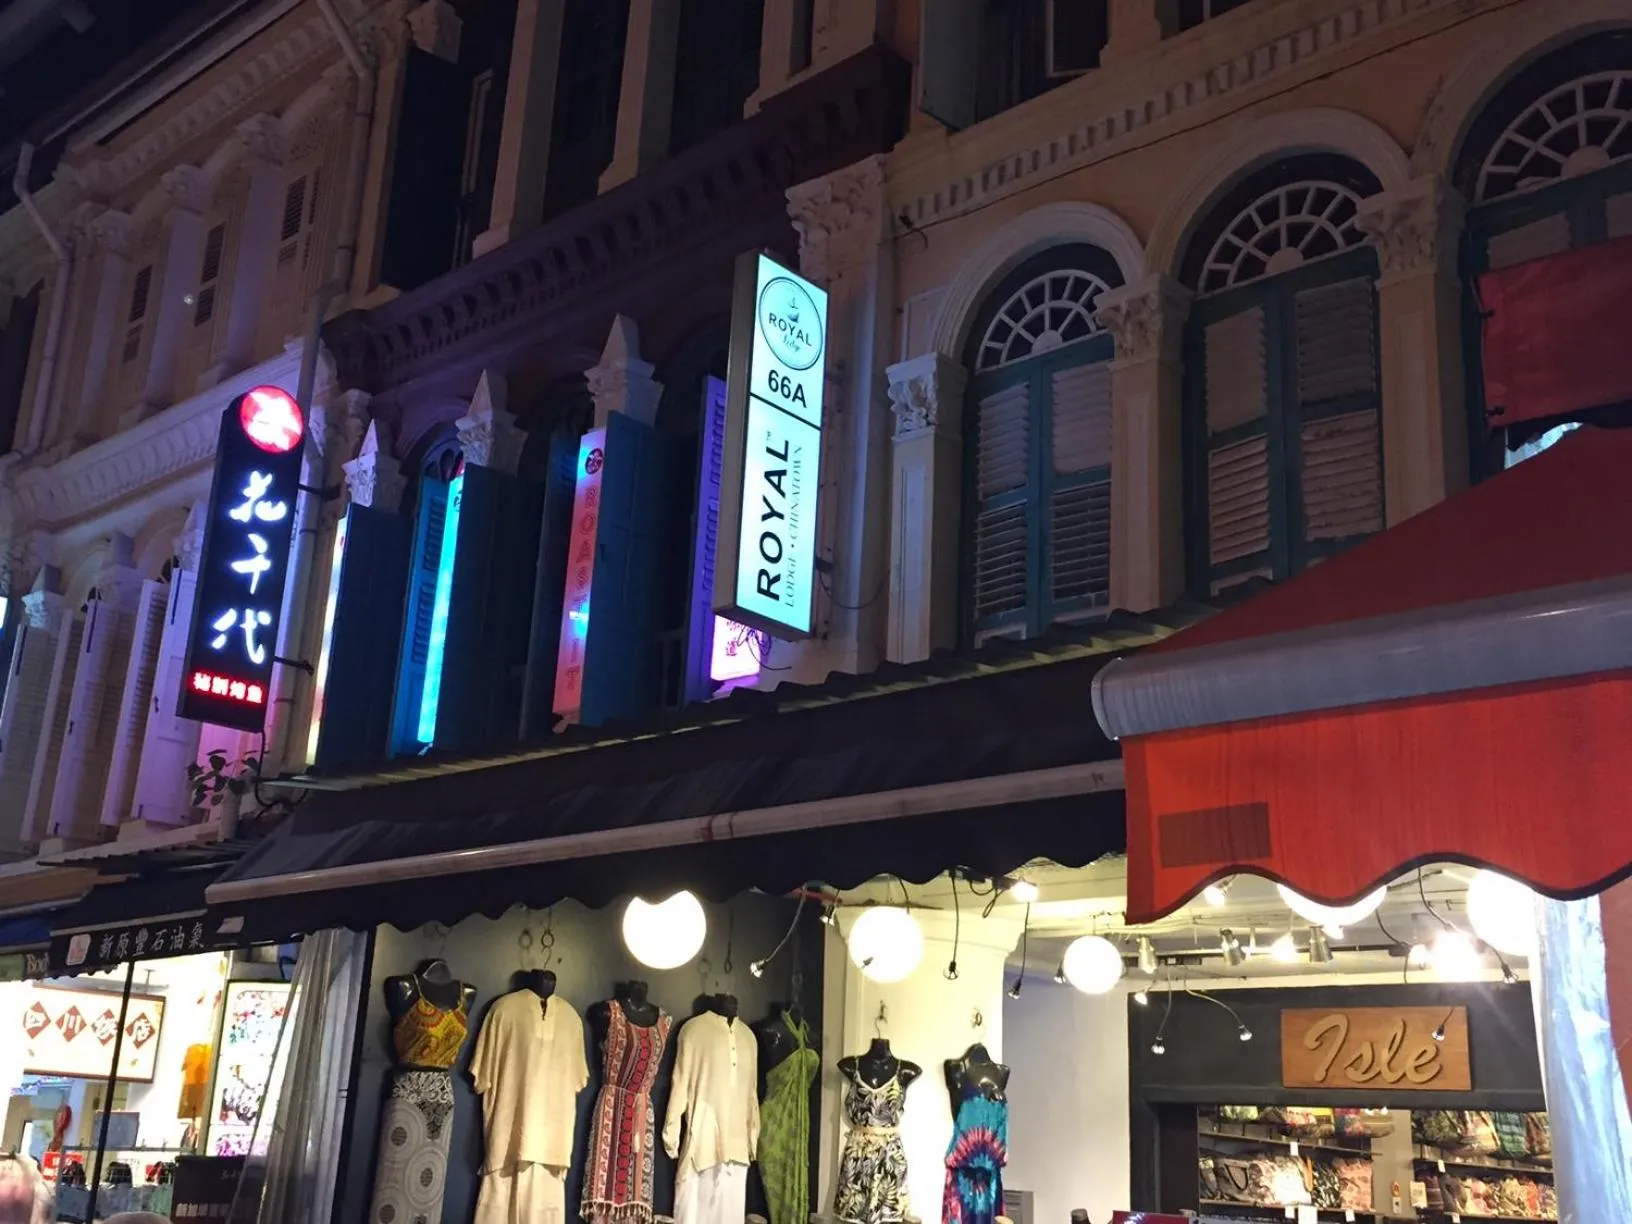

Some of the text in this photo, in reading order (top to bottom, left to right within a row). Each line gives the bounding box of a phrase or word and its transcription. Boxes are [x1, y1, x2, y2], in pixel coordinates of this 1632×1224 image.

[768, 312, 812, 347] ROYAL
[767, 369, 807, 409] 66A
[756, 439, 789, 602] ROYAL
[784, 556, 797, 608] LODGE
[1304, 1013, 1444, 1085] Isle
